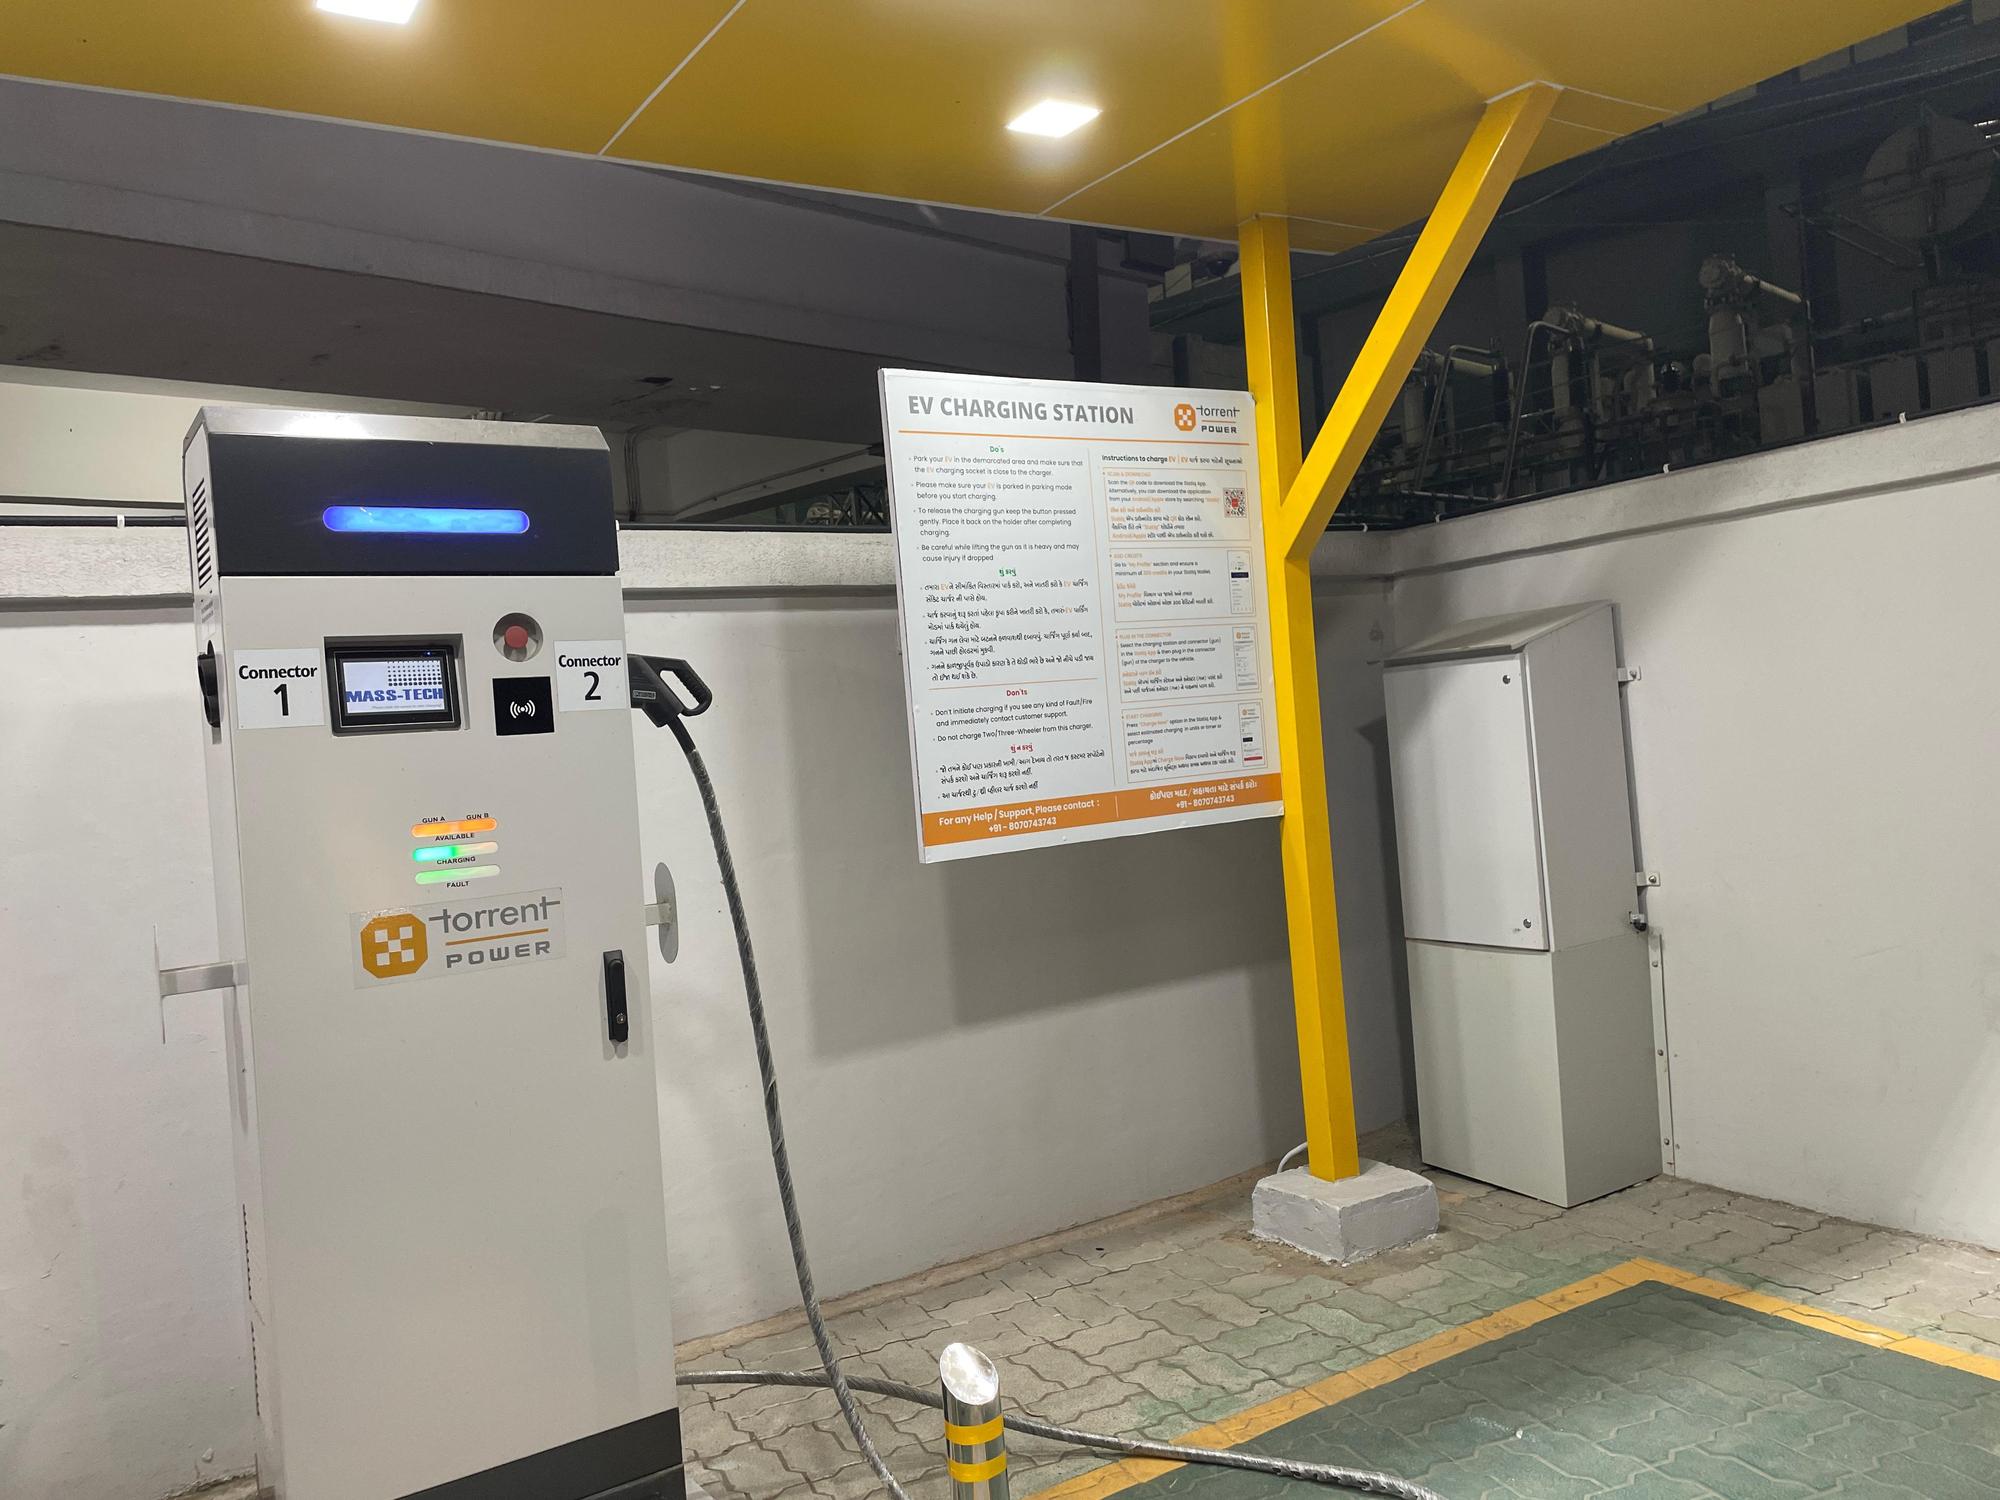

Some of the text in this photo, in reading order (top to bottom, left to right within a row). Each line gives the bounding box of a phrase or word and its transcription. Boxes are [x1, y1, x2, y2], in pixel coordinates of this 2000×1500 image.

[908, 396, 1134, 424] EV CHARGING STATION
[1196, 405, 1240, 417] torrent
[1146, 456, 1167, 464] charge
[935, 467, 964, 475] charging
[967, 493, 996, 501] charging.
[919, 518, 941, 526] gently.
[942, 518, 959, 526] Place
[920, 529, 950, 537] charging.
[559, 654, 621, 667] Connector
[239, 665, 317, 680] Connector
[584, 671, 601, 701] 2
[274, 684, 289, 716] 1
[345, 688, 444, 702] MASS-TECH
[950, 716, 989, 725] immediately
[982, 727, 1041, 737] Two/Three-Wheeler
[1193, 794, 1234, 806] 8070743743
[939, 817, 953, 825] For
[954, 815, 971, 823] any
[973, 812, 992, 821] Help
[998, 807, 1034, 819] Support,
[1035, 804, 1061, 813] Please
[1063, 800, 1094, 810] contact
[989, 824, 1001, 832] +91
[1008, 816, 1056, 830] 8070743743
[435, 833, 475, 841] AVAILABLE
[437, 856, 476, 864] CHARGING
[428, 896, 560, 933] torrent
[446, 941, 550, 968] POWER
